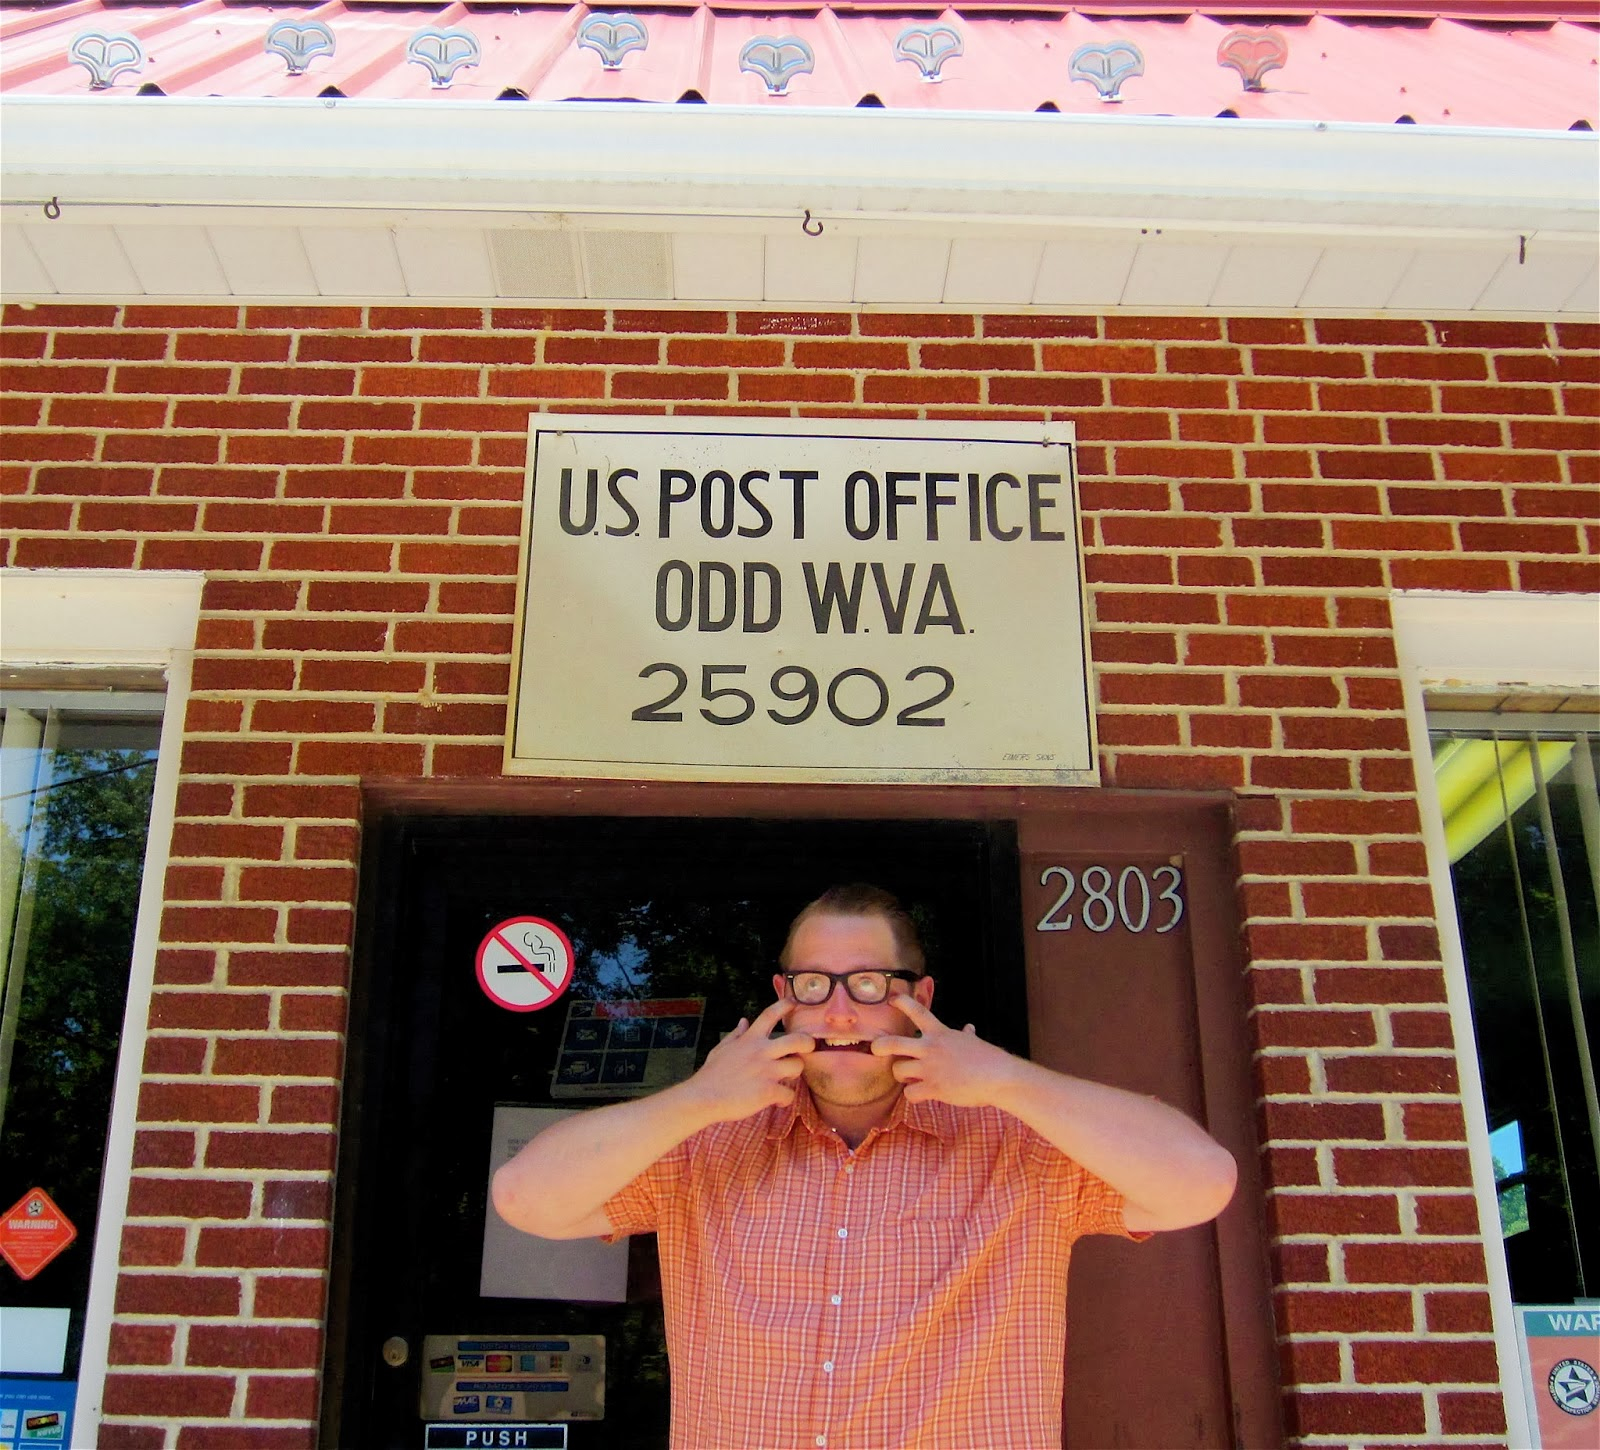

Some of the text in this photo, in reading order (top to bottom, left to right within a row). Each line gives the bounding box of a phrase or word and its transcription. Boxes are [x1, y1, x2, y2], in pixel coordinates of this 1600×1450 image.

[658, 470, 819, 539] POST
[845, 471, 1066, 542] OFFICE
[655, 559, 975, 635] ODD W.VA.
[631, 662, 955, 727] 25902
[1036, 865, 1184, 933] 2803
[9, 1219, 58, 1229] WARNING!
[466, 1430, 528, 1446] PUSH
